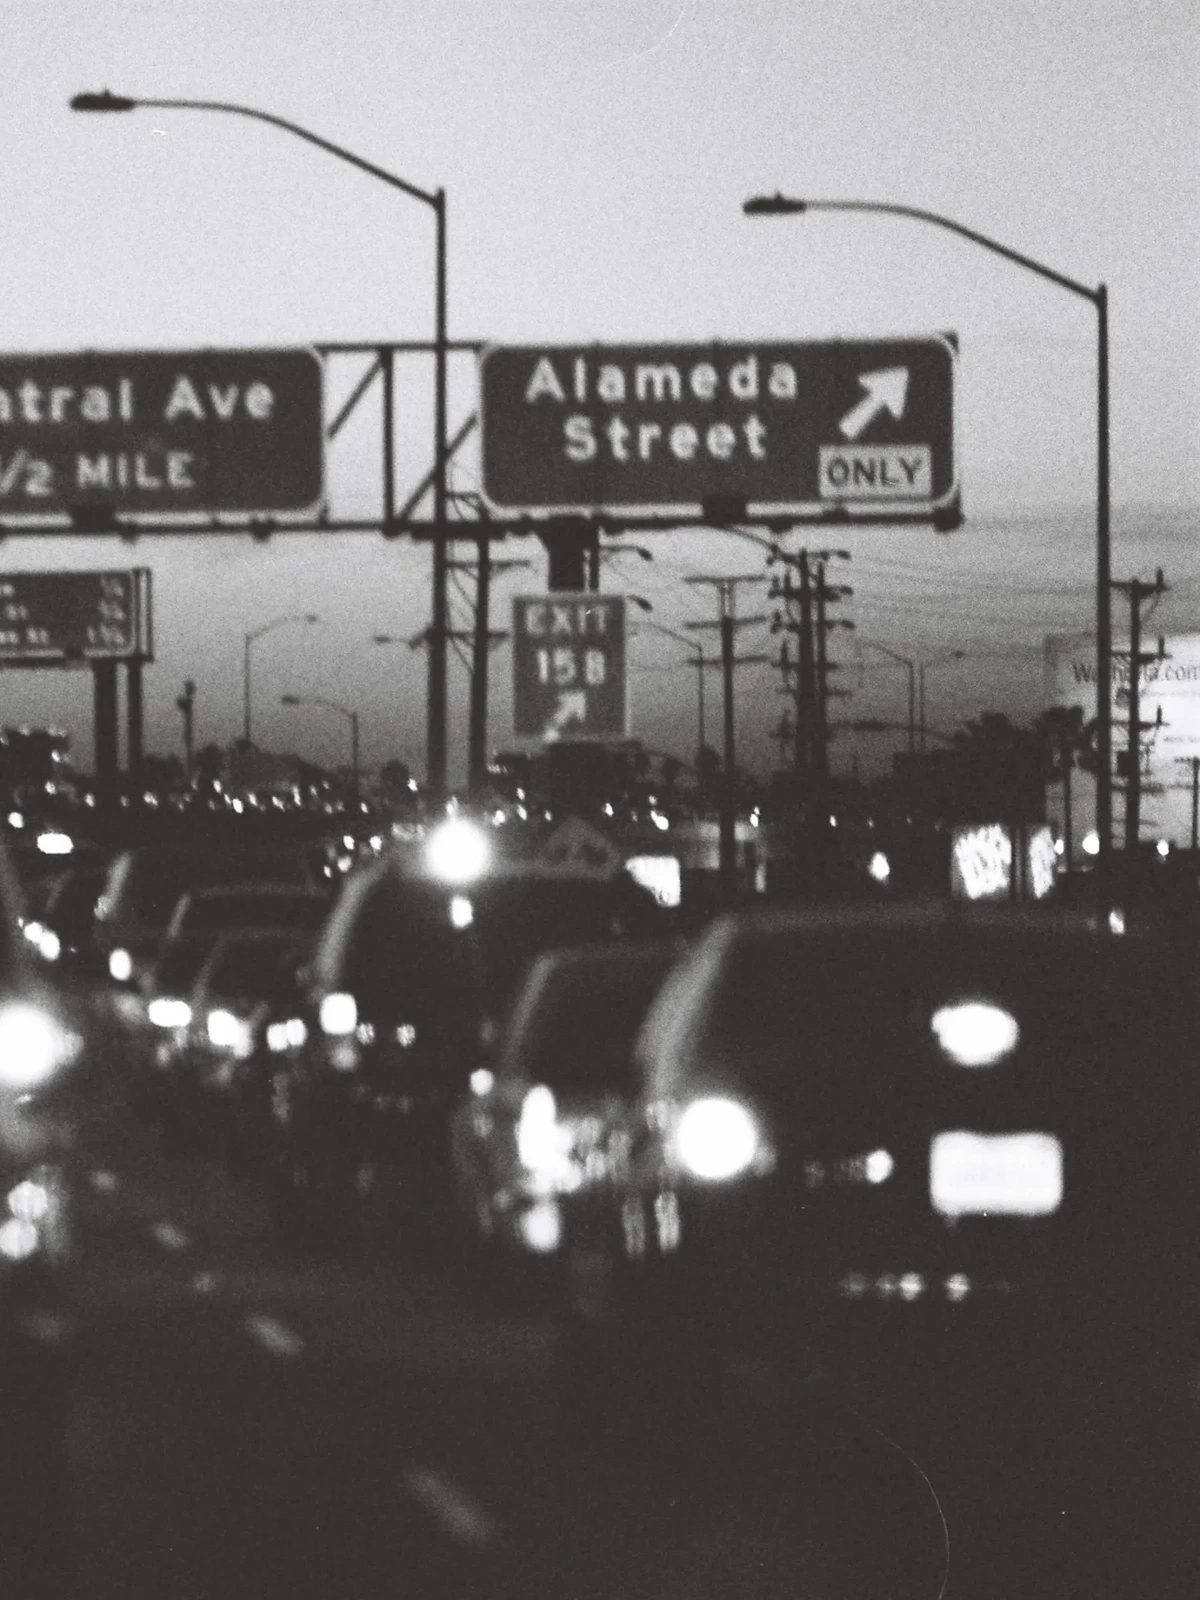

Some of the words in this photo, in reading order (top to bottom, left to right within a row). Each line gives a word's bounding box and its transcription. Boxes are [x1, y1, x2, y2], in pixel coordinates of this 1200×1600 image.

[164, 374, 276, 421] Ave
[525, 356, 799, 403] Alameda
[563, 413, 768, 463] Street
[76, 450, 198, 489] MILE
[826, 455, 924, 488] ONLY
[525, 604, 608, 637] EXIT
